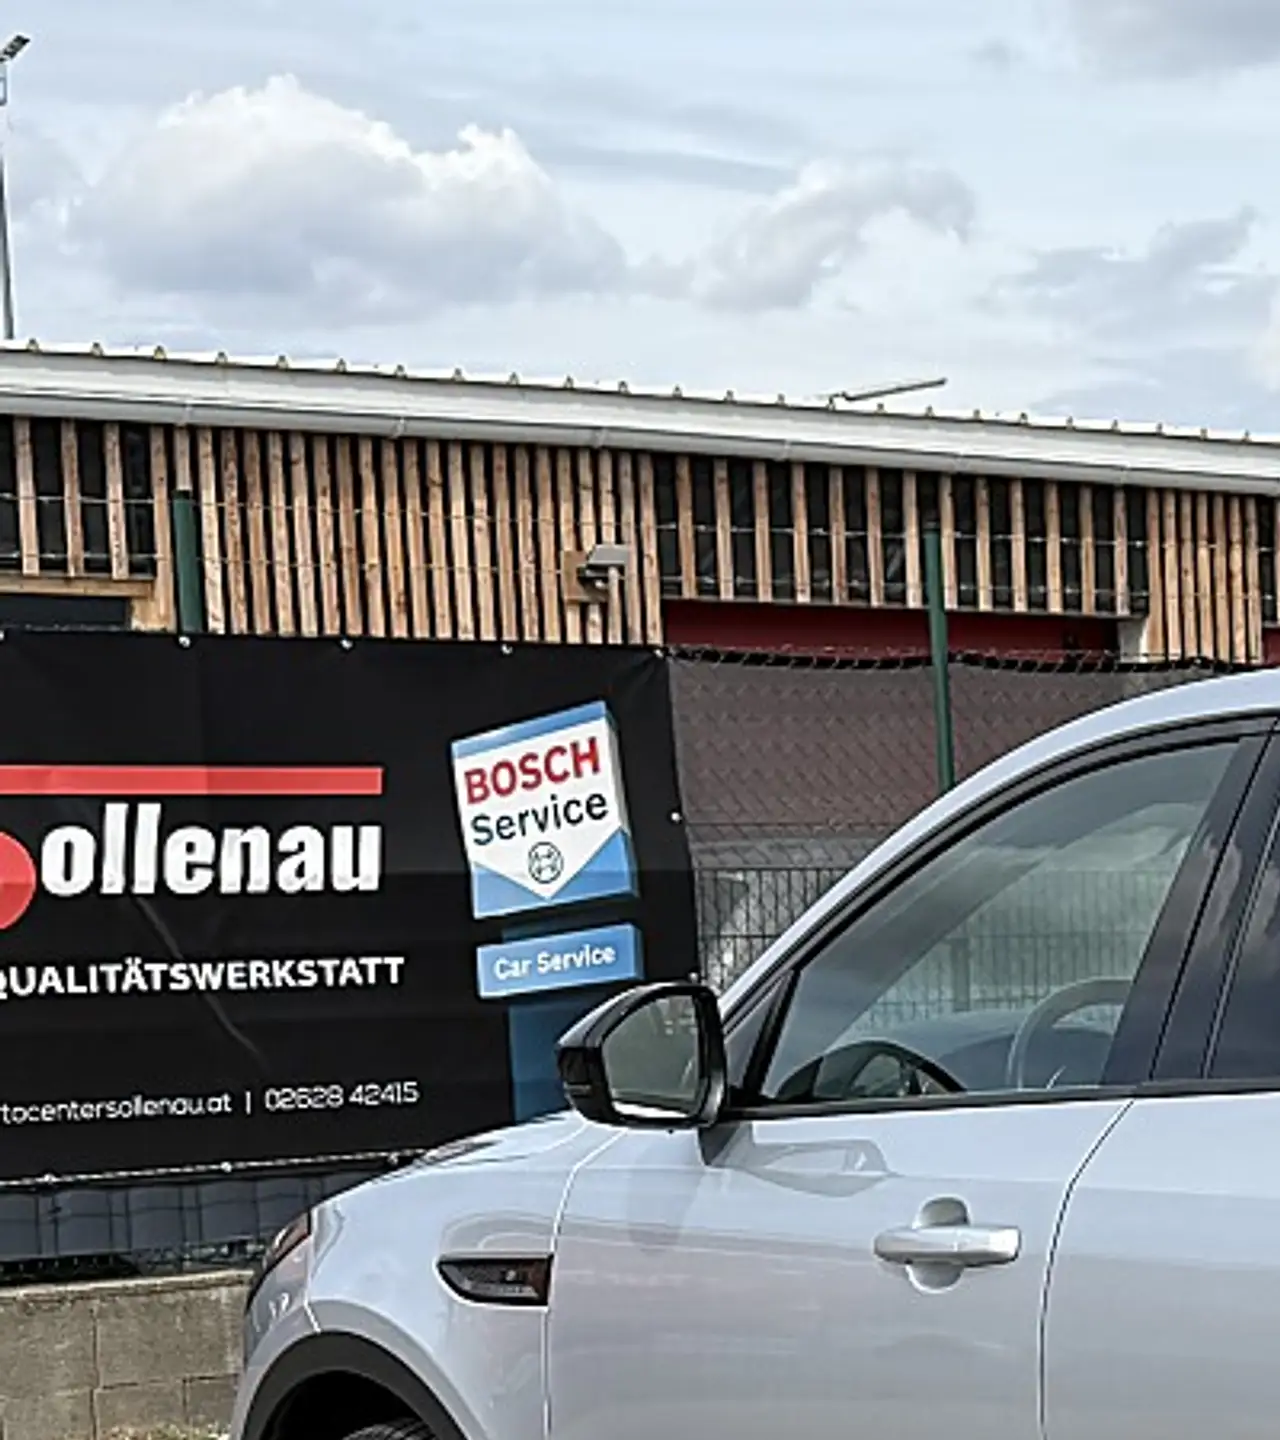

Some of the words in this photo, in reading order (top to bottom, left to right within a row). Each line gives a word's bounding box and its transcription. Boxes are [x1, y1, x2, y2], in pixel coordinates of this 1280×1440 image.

[464, 736, 602, 805] BOSCH
[471, 792, 609, 846] Service
[493, 957, 531, 981] Car
[537, 943, 617, 974] Service
[264, 1083, 344, 1112] 02628
[349, 1080, 420, 1106] 42415
